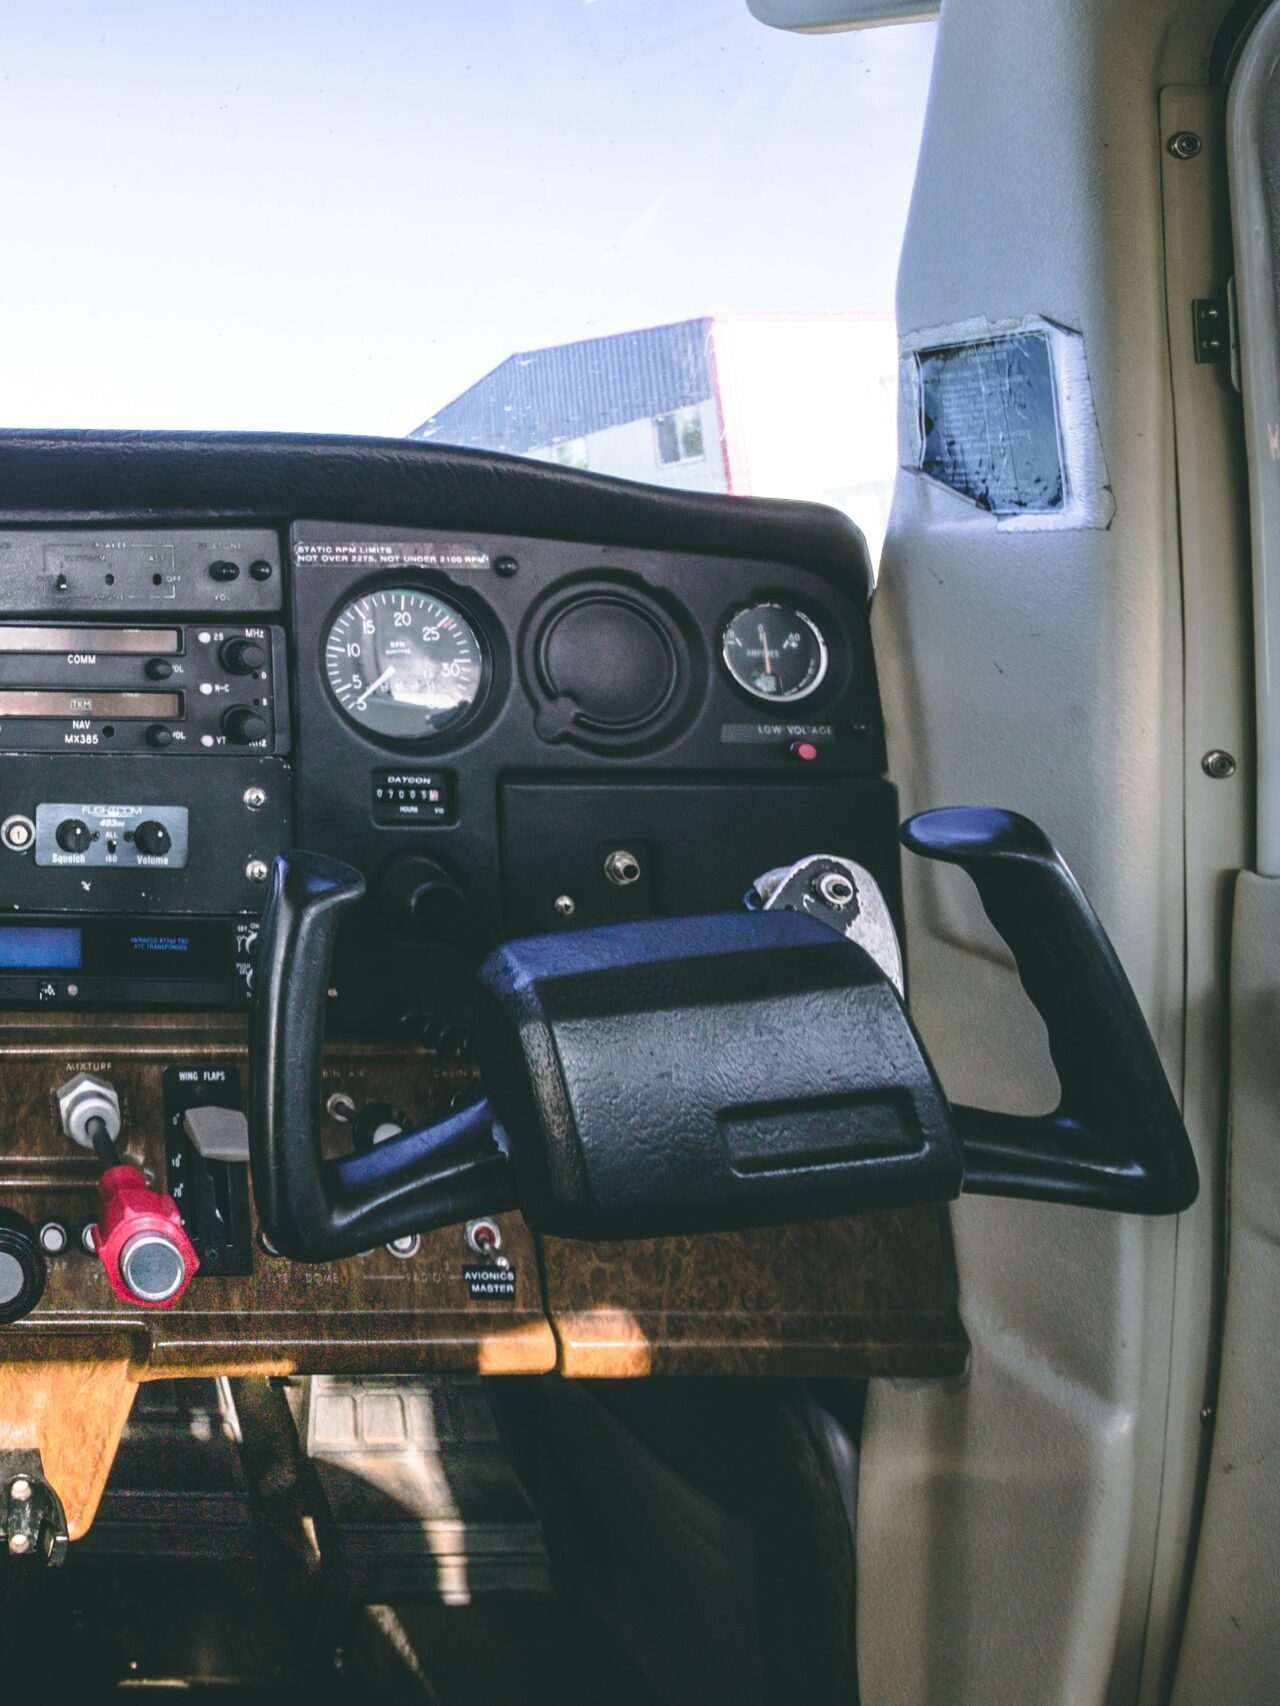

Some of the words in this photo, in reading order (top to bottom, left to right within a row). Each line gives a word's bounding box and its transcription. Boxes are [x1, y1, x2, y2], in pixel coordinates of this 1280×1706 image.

[297, 546, 332, 554] STATIC
[335, 546, 357, 554] RPM
[297, 554, 318, 563] NOT
[321, 555, 348, 563] OVER
[380, 555, 400, 563] NOT
[403, 555, 437, 563] UNDER
[440, 556, 462, 564] 2100
[393, 612, 412, 626] 20
[362, 620, 376, 635] 15
[758, 623, 765, 632] 0
[245, 628, 265, 639] MHz
[422, 626, 440, 641] 25
[346, 643, 361, 657] 10
[67, 655, 96, 665] COMM
[172, 665, 185, 674] OL
[441, 662, 460, 677] 30
[352, 675, 363, 689] 5
[72, 700, 91, 709] TKM
[72, 720, 91, 730] NAV
[758, 725, 782, 735] LOW
[787, 725, 832, 736] VOLTAGE
[64, 734, 99, 744] MX385
[216, 736, 227, 744] VT
[387, 776, 431, 784] DATCON
[105, 831, 118, 839] ALL
[51, 853, 86, 864] Squelch
[137, 855, 169, 866] Volume
[250, 922, 260, 930] ON
[65, 1062, 112, 1071] MIXTURE
[179, 1071, 198, 1081] WING
[203, 1071, 226, 1081] FLAPS
[464, 1271, 515, 1282] AVIONICS
[471, 1284, 514, 1294] MASTER
